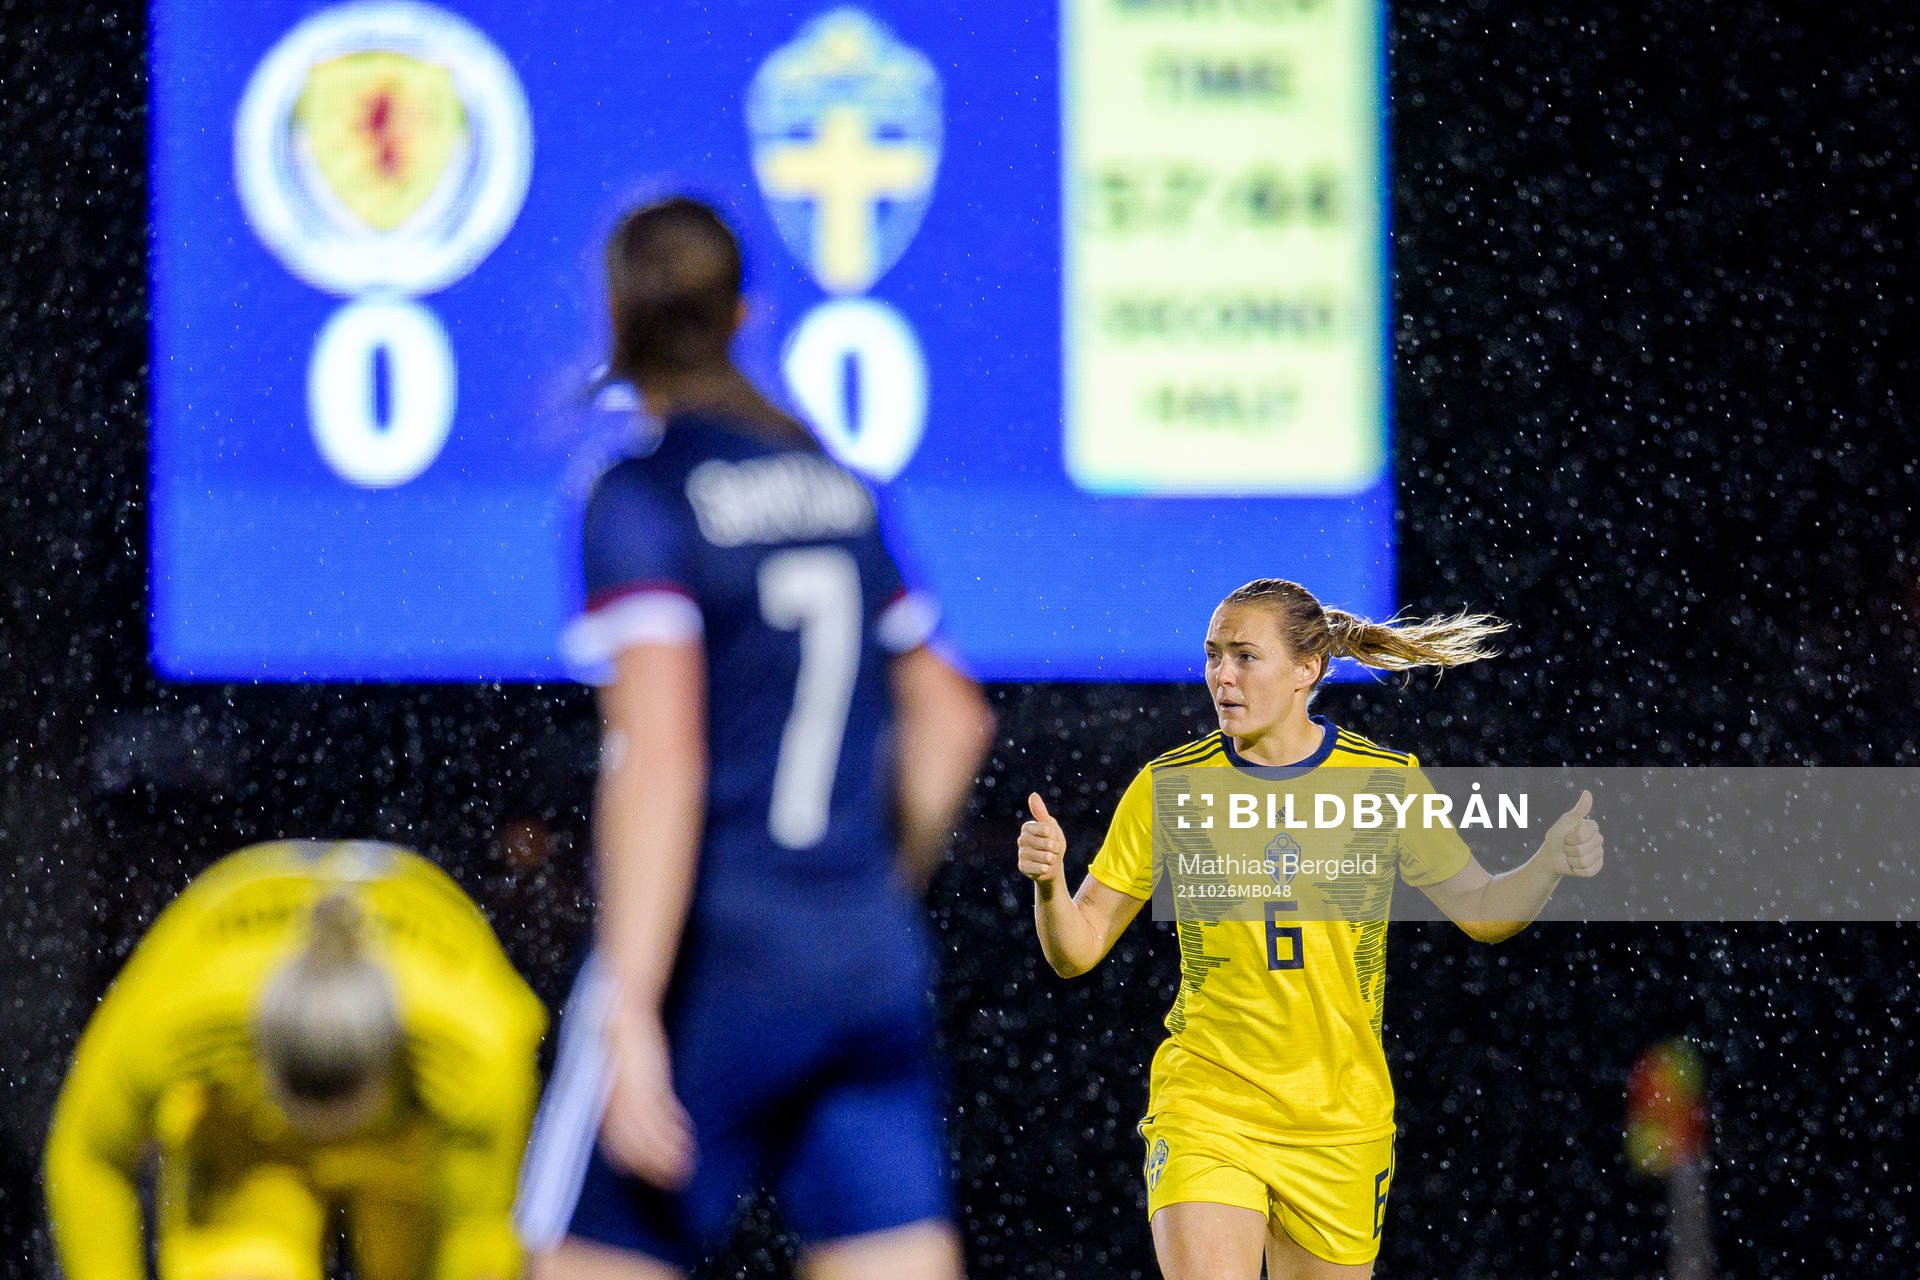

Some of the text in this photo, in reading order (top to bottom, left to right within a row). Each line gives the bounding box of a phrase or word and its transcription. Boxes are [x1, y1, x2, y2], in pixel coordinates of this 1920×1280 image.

[309, 297, 457, 488] 0
[781, 297, 928, 484] 0
[758, 547, 863, 850] 7
[1264, 902, 1304, 971] 6
